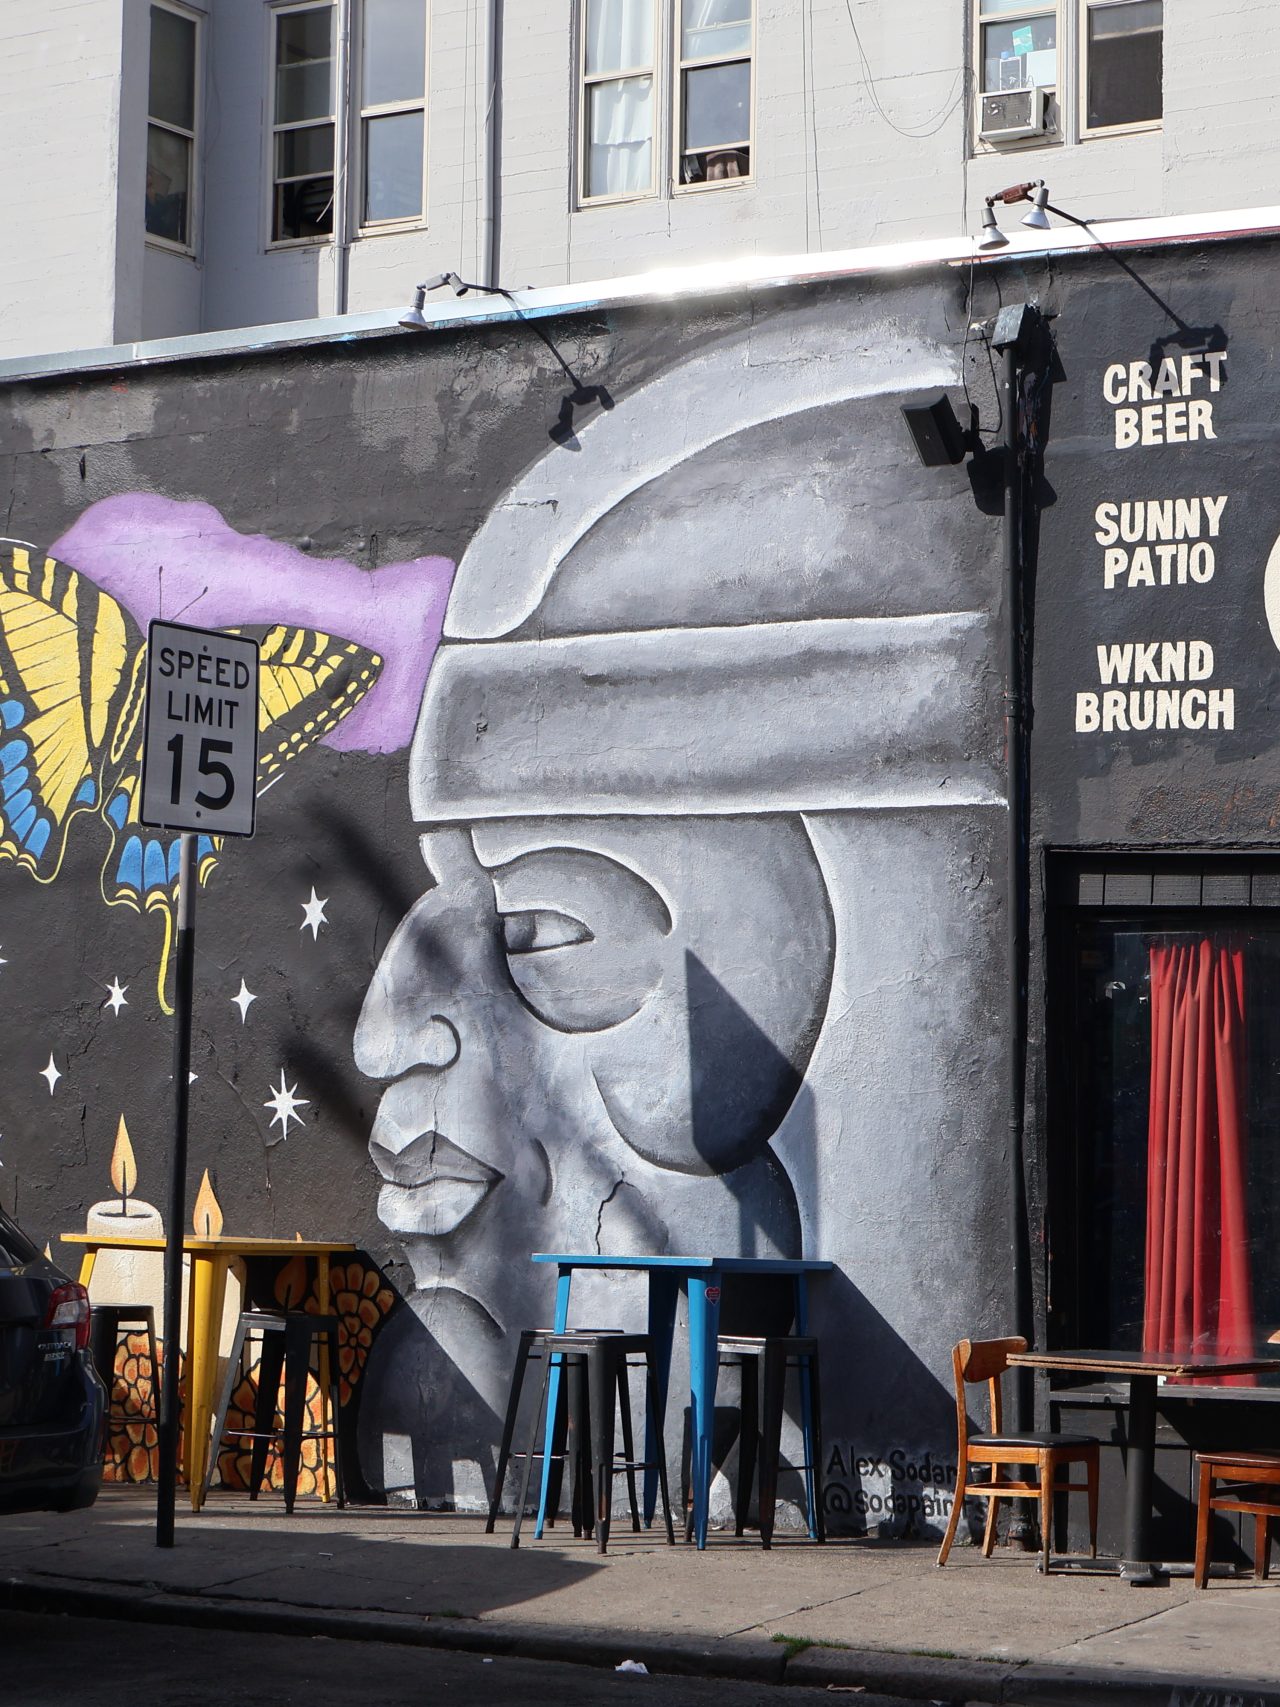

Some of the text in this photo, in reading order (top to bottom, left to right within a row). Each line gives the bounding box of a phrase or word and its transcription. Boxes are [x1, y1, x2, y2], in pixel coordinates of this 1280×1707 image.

[1103, 351, 1228, 404] CRAFT
[1115, 400, 1218, 449] BEER
[1095, 496, 1228, 546] SUNNY
[1104, 542, 1215, 589] PATIO
[159, 647, 249, 689] SPEED
[1097, 640, 1214, 684] WKND
[168, 690, 239, 729] LIMIT
[1075, 689, 1235, 732] BRUNCH
[168, 734, 235, 810] 15
[827, 1445, 885, 1478] Alex
